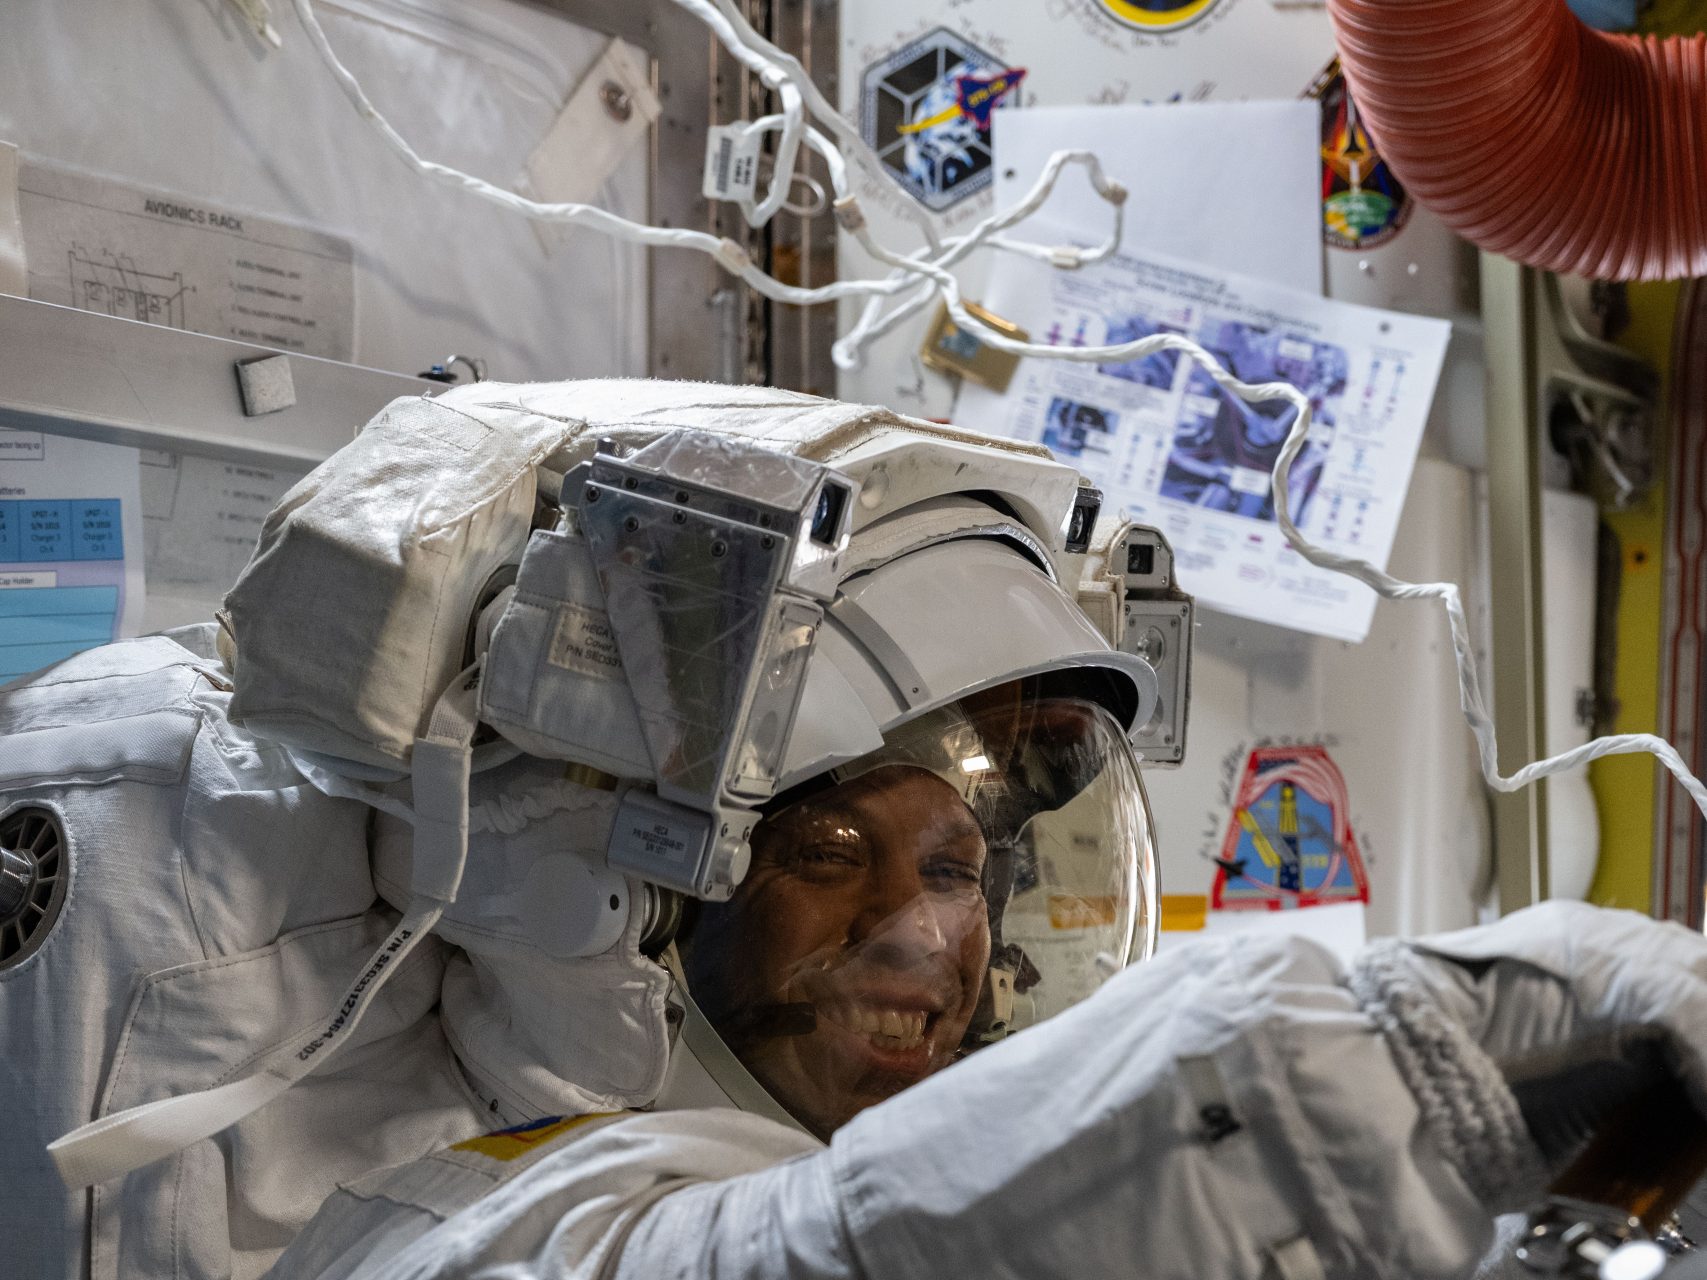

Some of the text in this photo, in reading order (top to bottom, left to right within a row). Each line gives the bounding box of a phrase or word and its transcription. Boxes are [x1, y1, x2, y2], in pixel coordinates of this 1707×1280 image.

[144, 199, 243, 231] AVIONICS RACK
[582, 622, 609, 637] HECA
[387, 930, 412, 953] P/N
